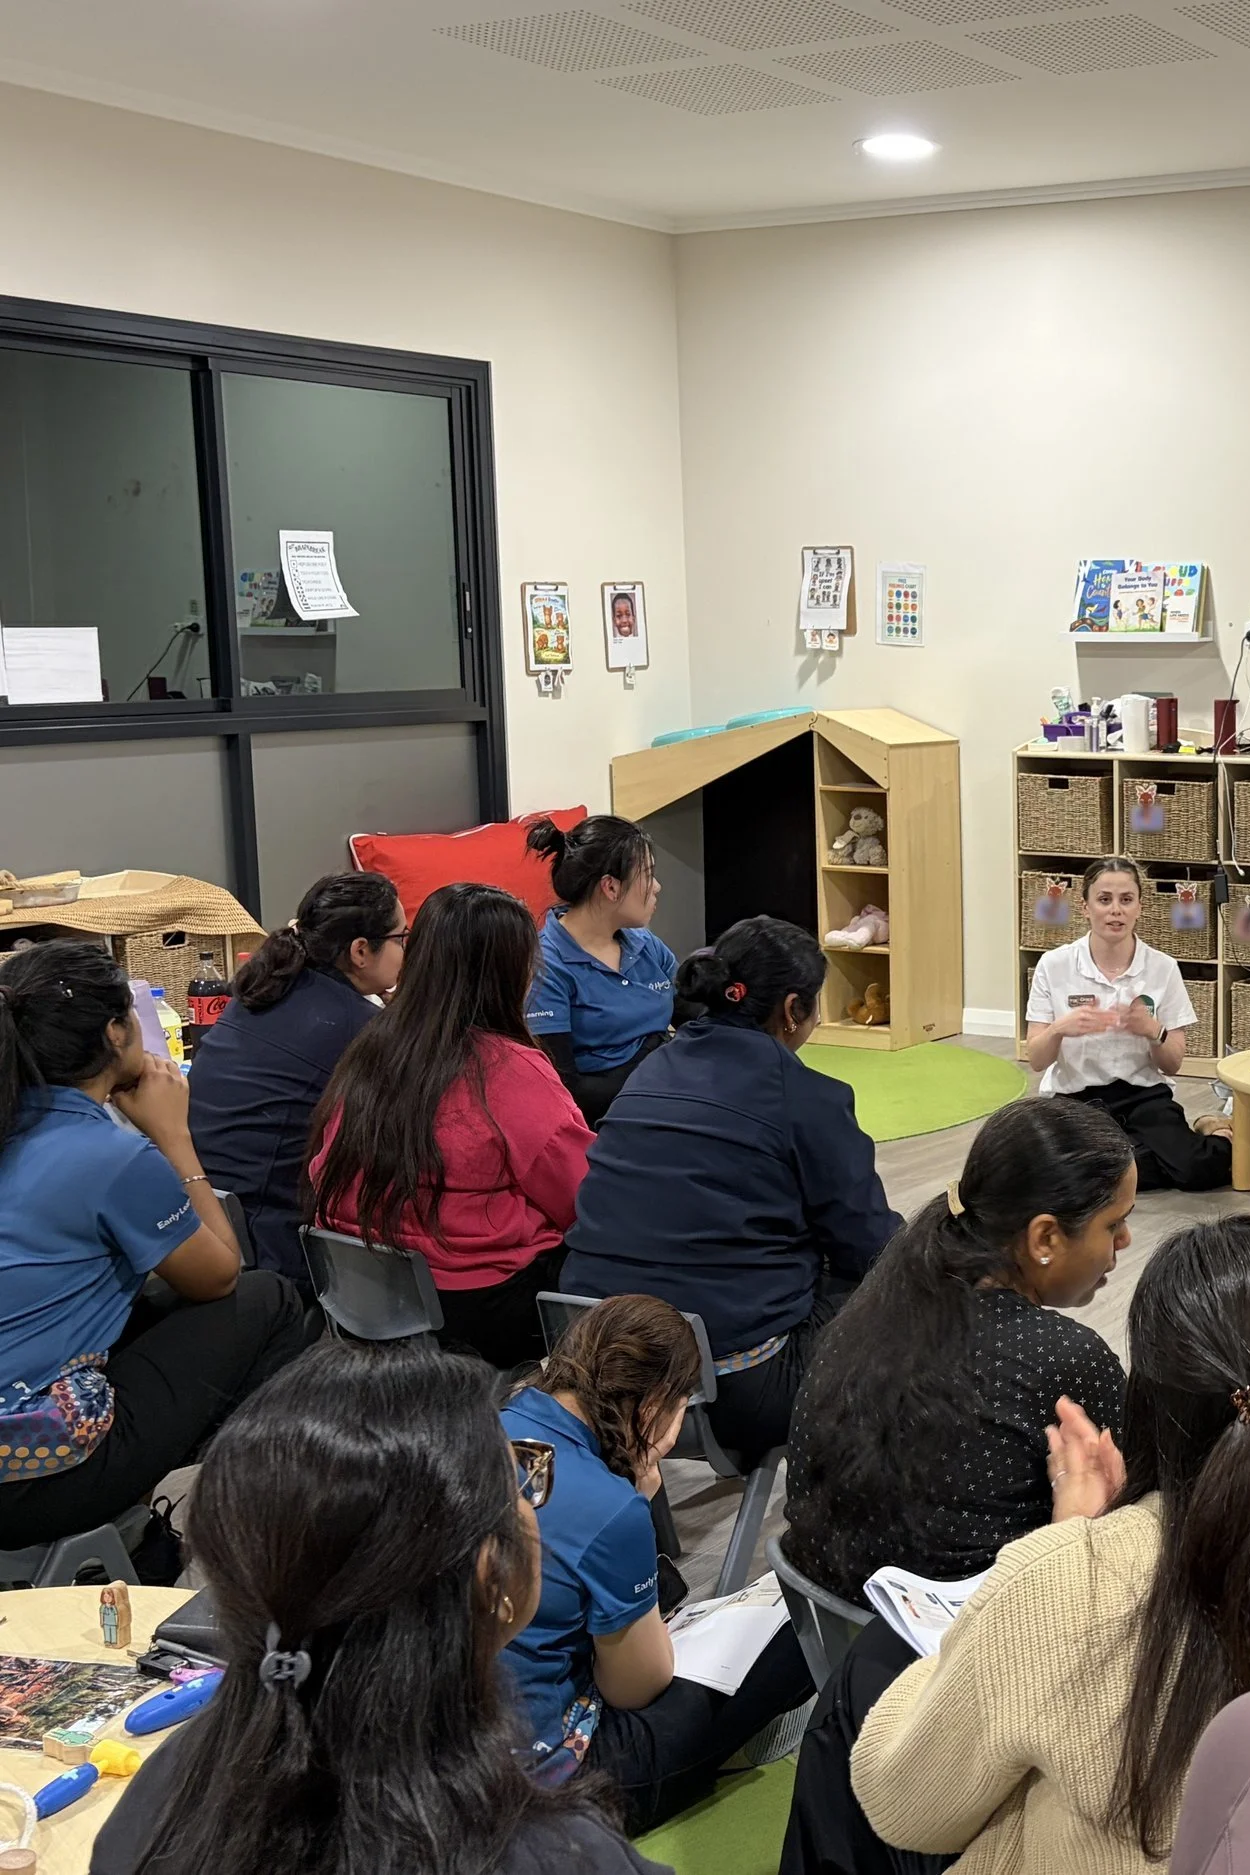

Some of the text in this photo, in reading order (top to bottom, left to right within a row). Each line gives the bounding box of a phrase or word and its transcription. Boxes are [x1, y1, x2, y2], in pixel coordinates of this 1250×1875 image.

[1117, 583, 1140, 591] Belongs
[526, 1010, 554, 1019] earning
[156, 1212, 180, 1230] Early
[633, 1576, 655, 1594] Early
